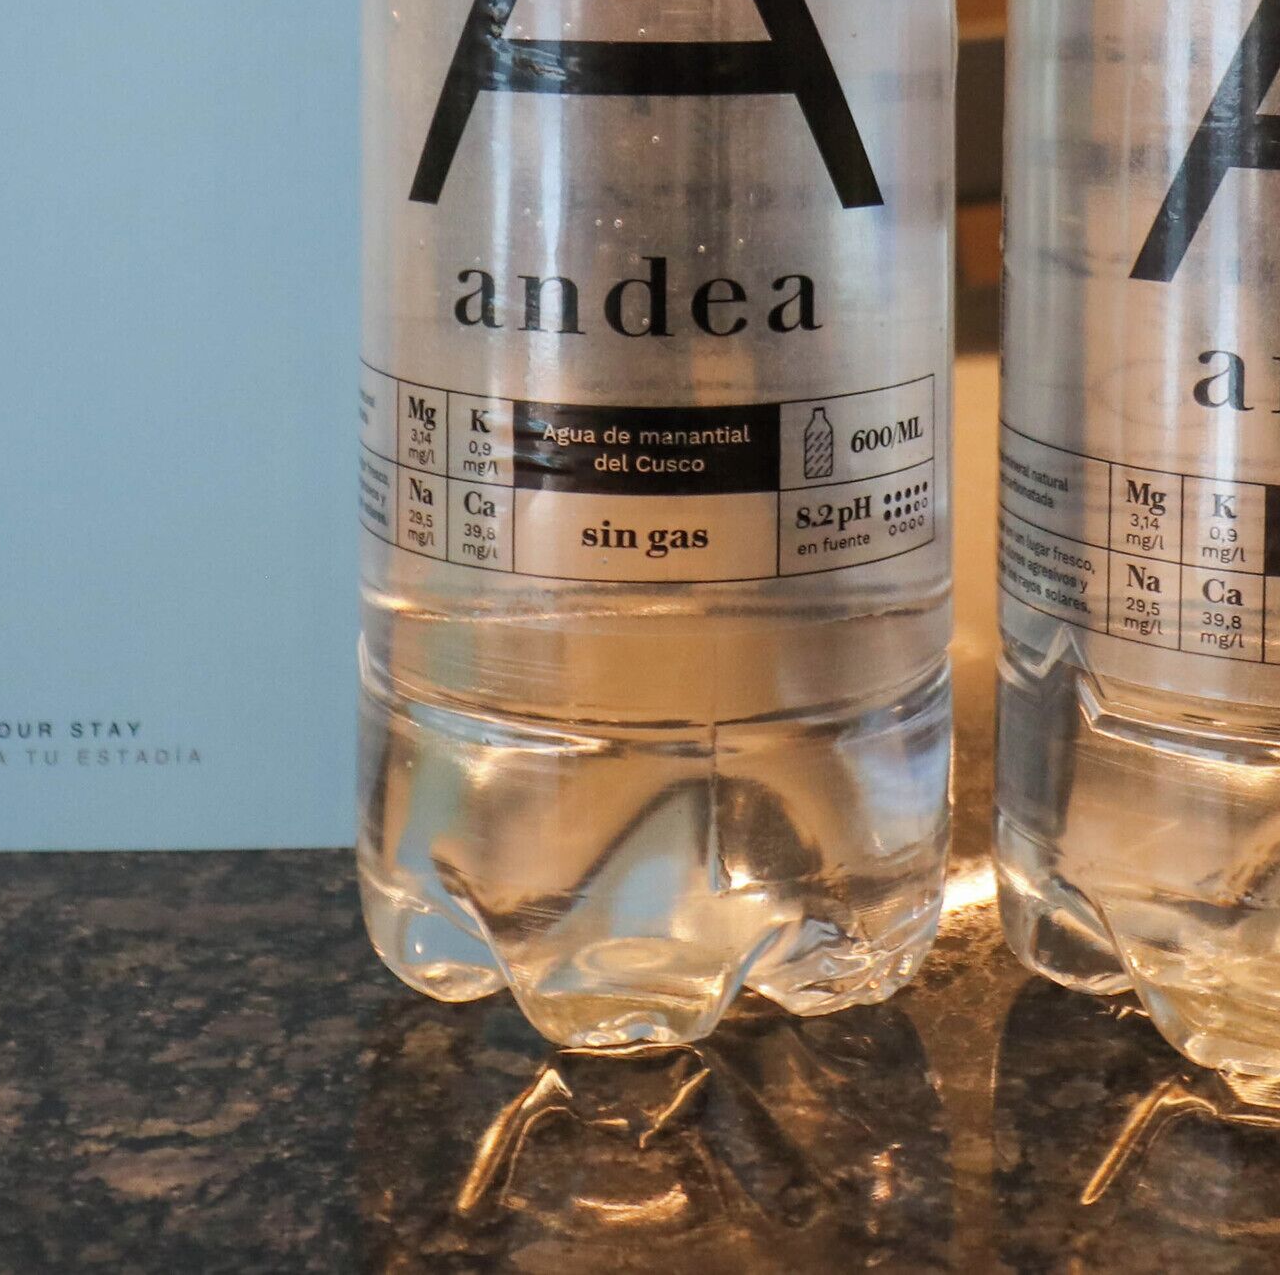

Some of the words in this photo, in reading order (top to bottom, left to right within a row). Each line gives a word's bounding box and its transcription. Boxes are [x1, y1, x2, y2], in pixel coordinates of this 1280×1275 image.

[453, 256, 823, 339] andea
[408, 396, 436, 430] Mg
[470, 409, 491, 433] K
[411, 428, 432, 445] 3,14
[543, 425, 596, 446] Agua
[603, 426, 631, 445] de
[639, 424, 751, 446] manantial
[851, 416, 923, 453] 600/ML
[408, 446, 435, 466] mg/l
[469, 440, 492, 457] 0,9
[463, 459, 498, 477] mg/l
[594, 454, 629, 472] del
[636, 456, 705, 473] Cusco
[1031, 470, 1068, 492] natural
[408, 477, 433, 506] Na
[1126, 479, 1167, 516] Mg
[464, 490, 496, 518] Ca
[1212, 493, 1237, 520] K
[408, 509, 433, 528] 29,5
[1130, 513, 1160, 530] 3,14
[407, 528, 435, 547] mg/l
[582, 520, 638, 549] sin
[645, 527, 709, 559] gas
[797, 542, 817, 555] en
[823, 533, 871, 553] fuente
[1126, 532, 1164, 551] mg/l
[1209, 526, 1237, 543] 0,9
[462, 542, 498, 560] mg/l
[1026, 534, 1050, 558] lugar
[1053, 546, 1095, 574] fresco,
[1202, 545, 1246, 564] mg/l
[1027, 558, 1077, 588] agresivos
[1080, 579, 1088, 594] y
[1126, 563, 1162, 593] Na
[1045, 586, 1091, 614] solares.
[1202, 578, 1245, 607] Ca
[1126, 597, 1160, 616] 29,5
[1124, 616, 1163, 635] mg/l
[1202, 611, 1242, 630] 39,8
[1200, 631, 1245, 650] mg/l
[70, 721, 142, 739] STAY
[25, 748, 60, 766] TU
[77, 746, 202, 766] ESTADÍA
